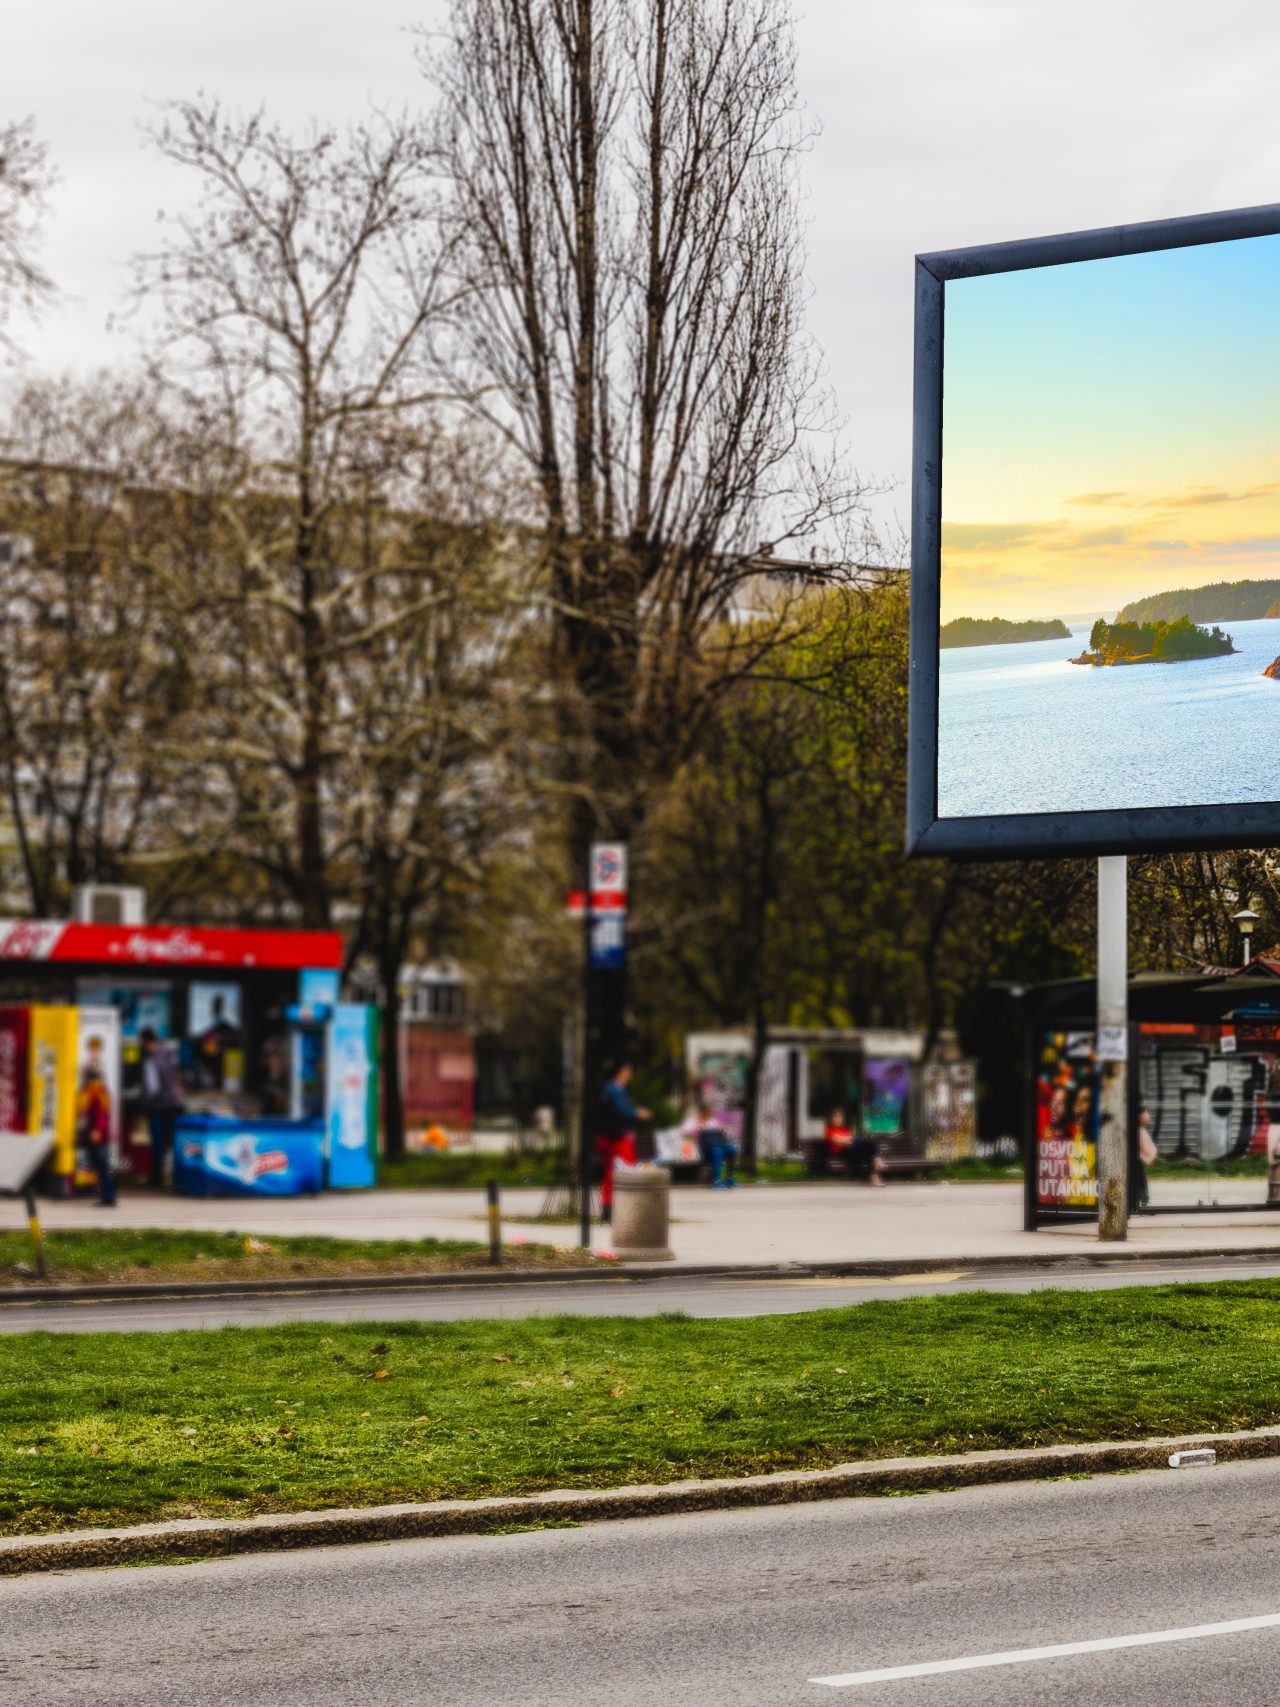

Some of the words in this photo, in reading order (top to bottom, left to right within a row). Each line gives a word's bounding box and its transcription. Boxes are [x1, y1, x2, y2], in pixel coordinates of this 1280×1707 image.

[1039, 1140, 1088, 1158] OSVOJI
[1039, 1159, 1068, 1177] PUT
[1069, 1160, 1090, 1177] NA
